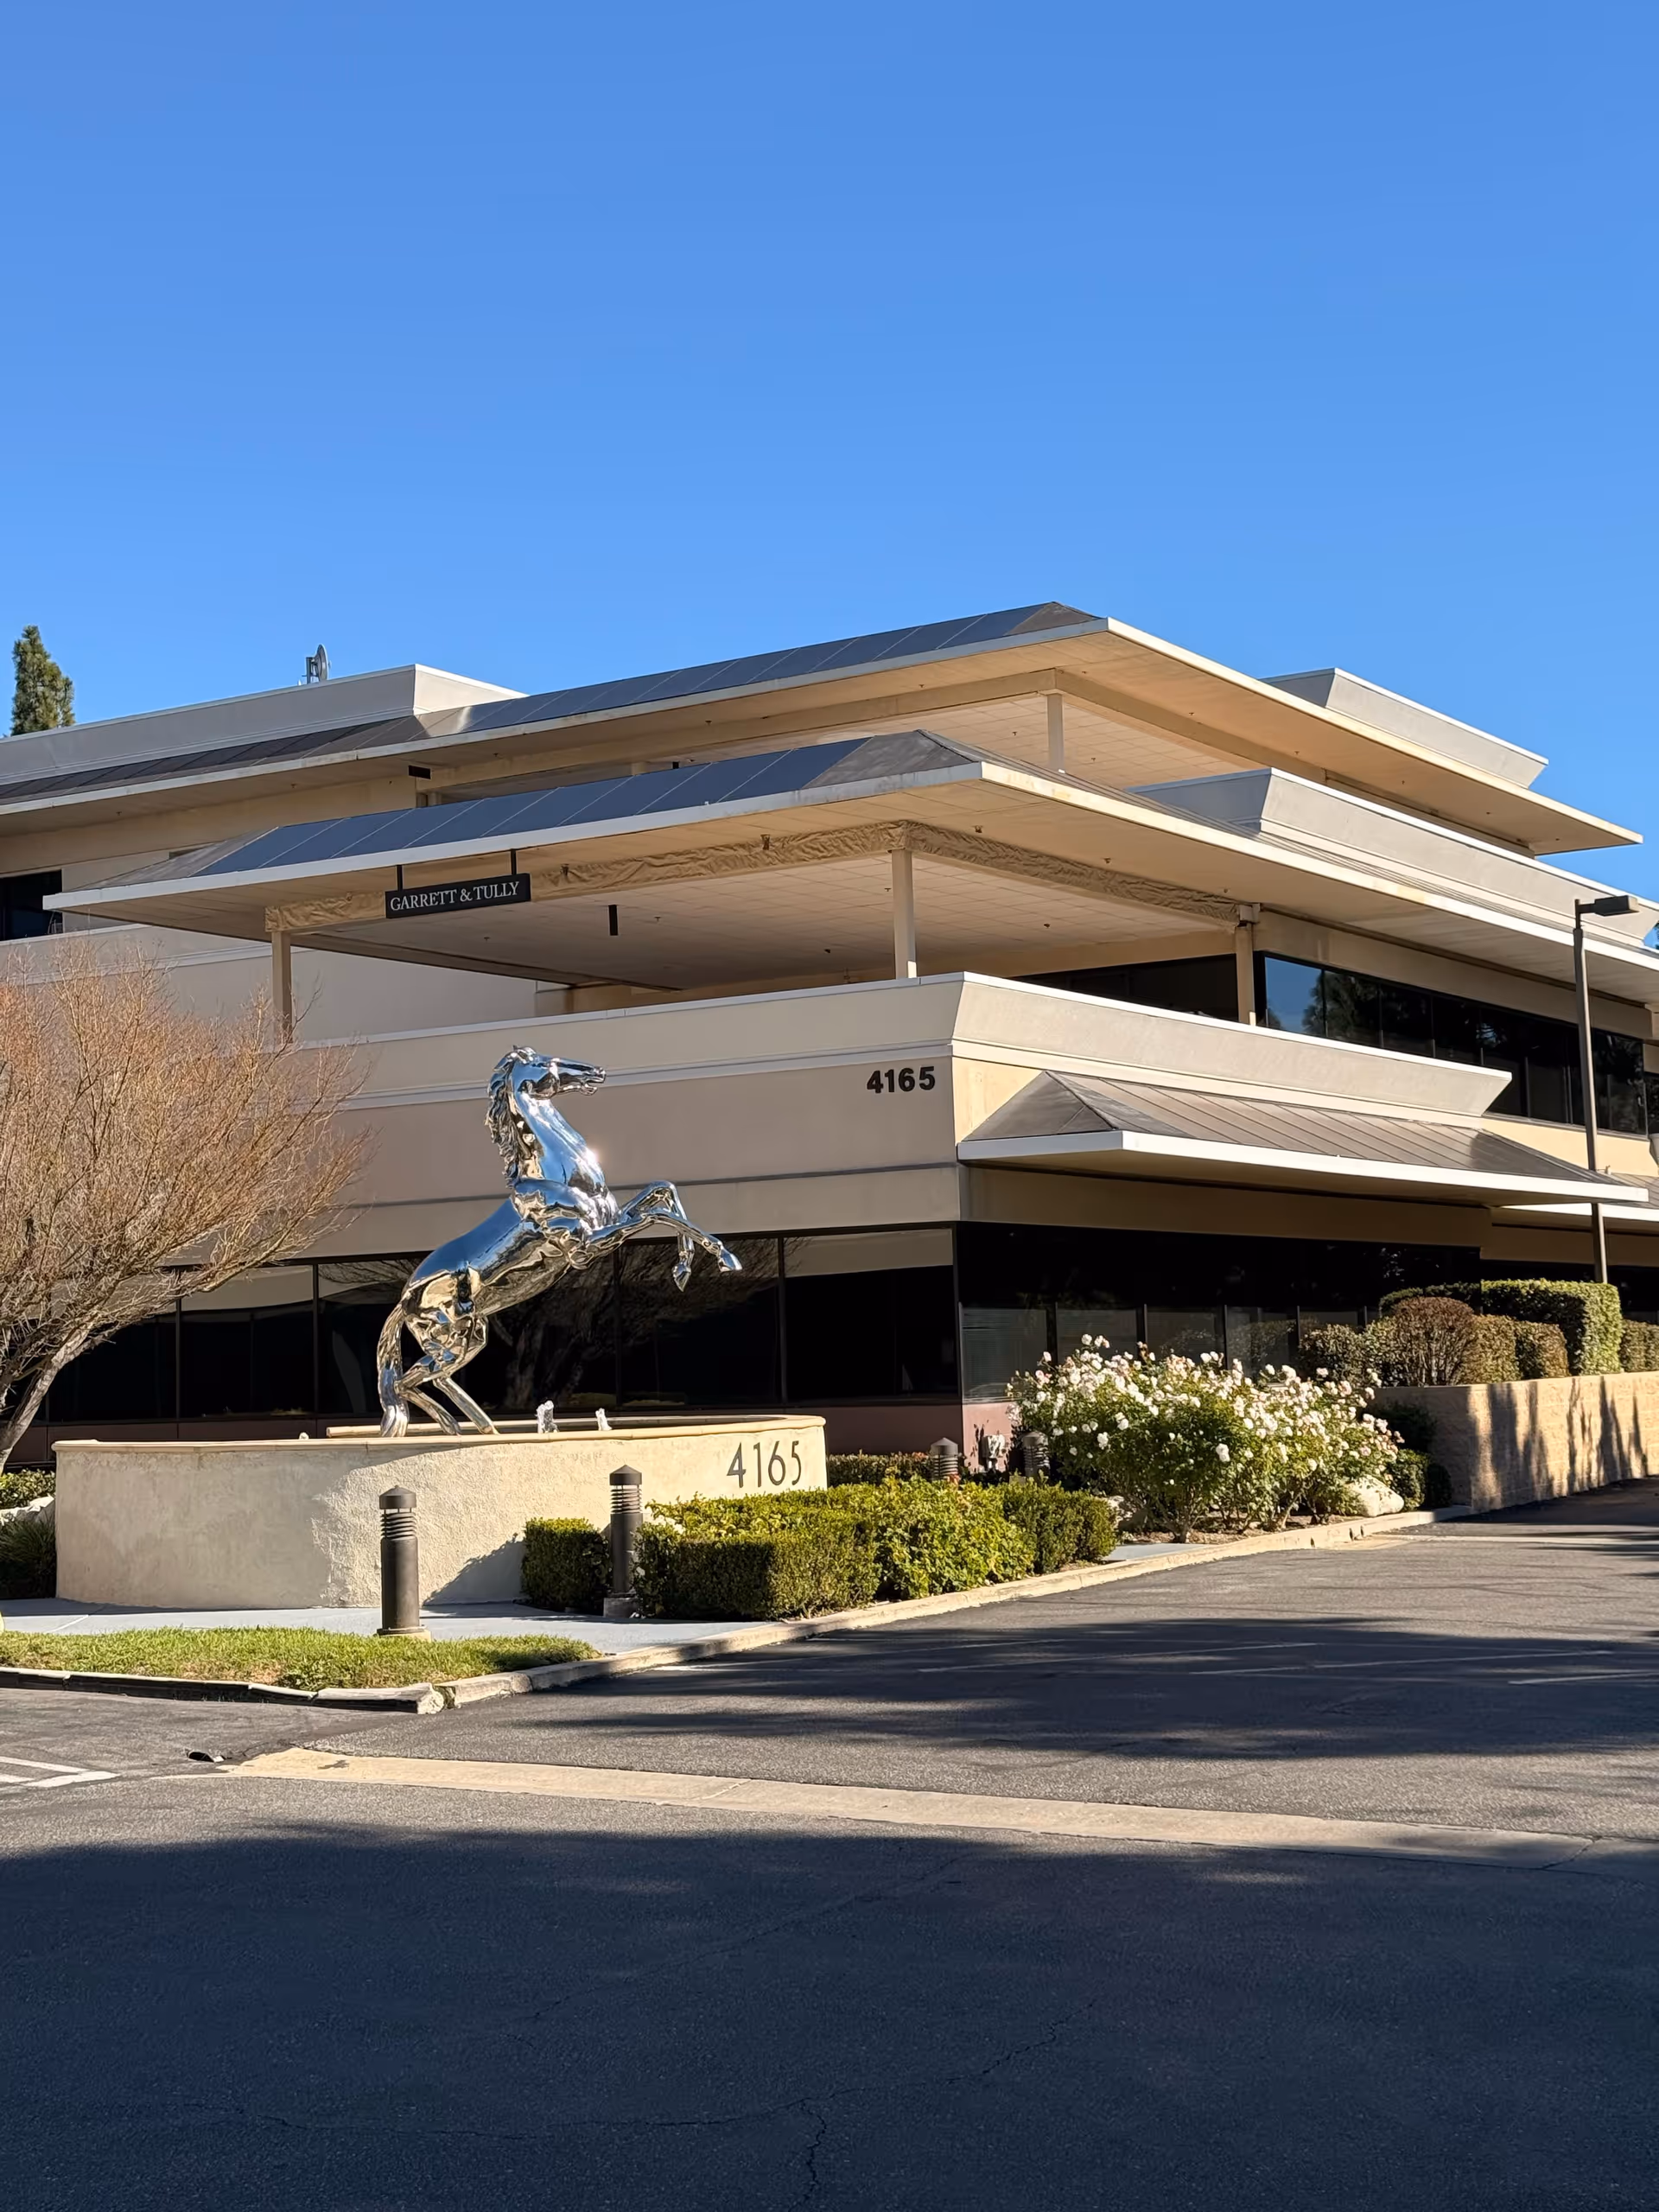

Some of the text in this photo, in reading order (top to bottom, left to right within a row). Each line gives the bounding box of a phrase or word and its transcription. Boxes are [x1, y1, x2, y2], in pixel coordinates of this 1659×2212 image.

[390, 881, 519, 911] GARRETT & TULLY
[867, 1066, 935, 1094] 4165
[726, 1440, 801, 1488] 4165
